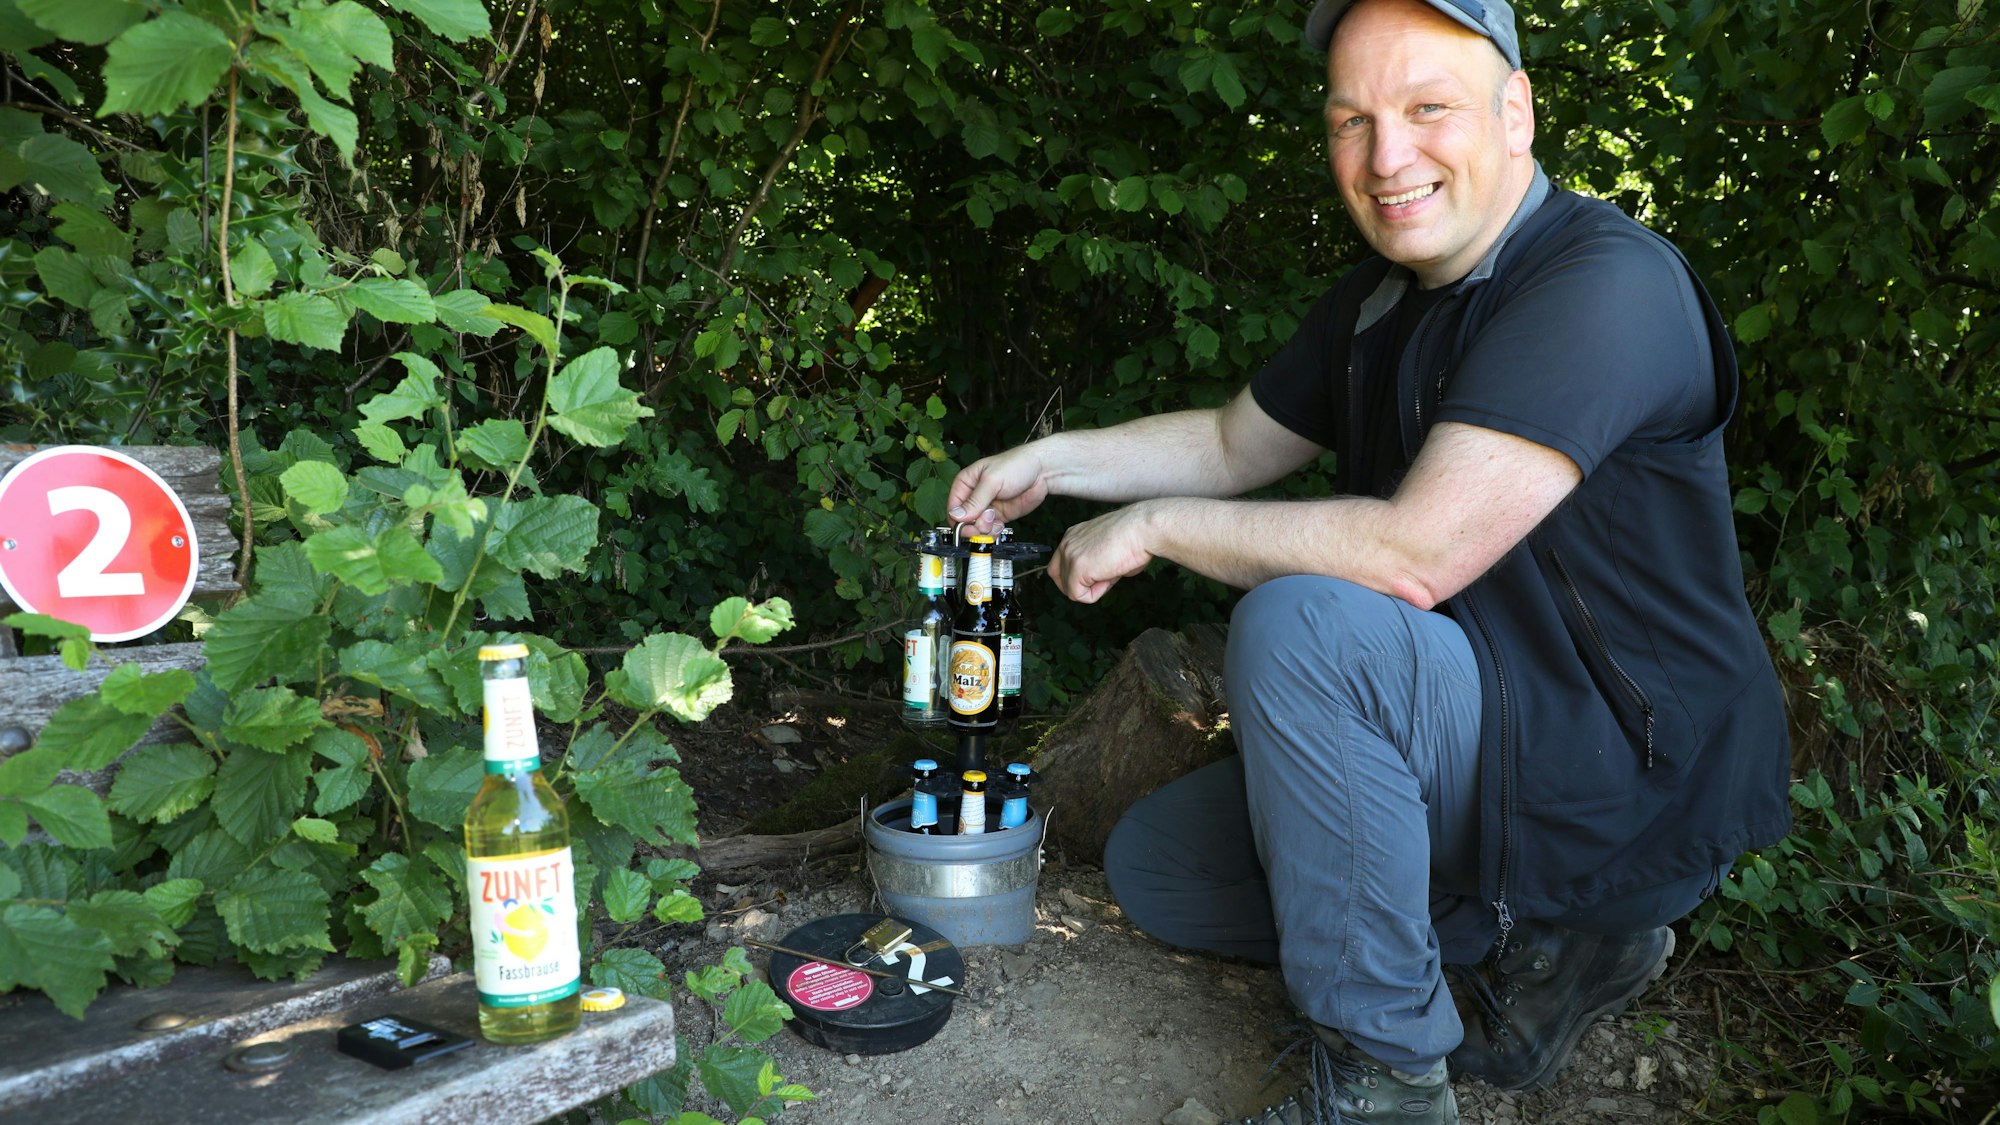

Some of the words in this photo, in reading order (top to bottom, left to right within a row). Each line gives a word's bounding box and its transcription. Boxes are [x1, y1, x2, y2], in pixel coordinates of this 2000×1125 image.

[47, 485, 145, 598] 2
[953, 673, 982, 687] Malz
[502, 695, 525, 751] ZUNFT
[480, 862, 561, 903] ZUNFT
[499, 961, 560, 981] Fassbrause
